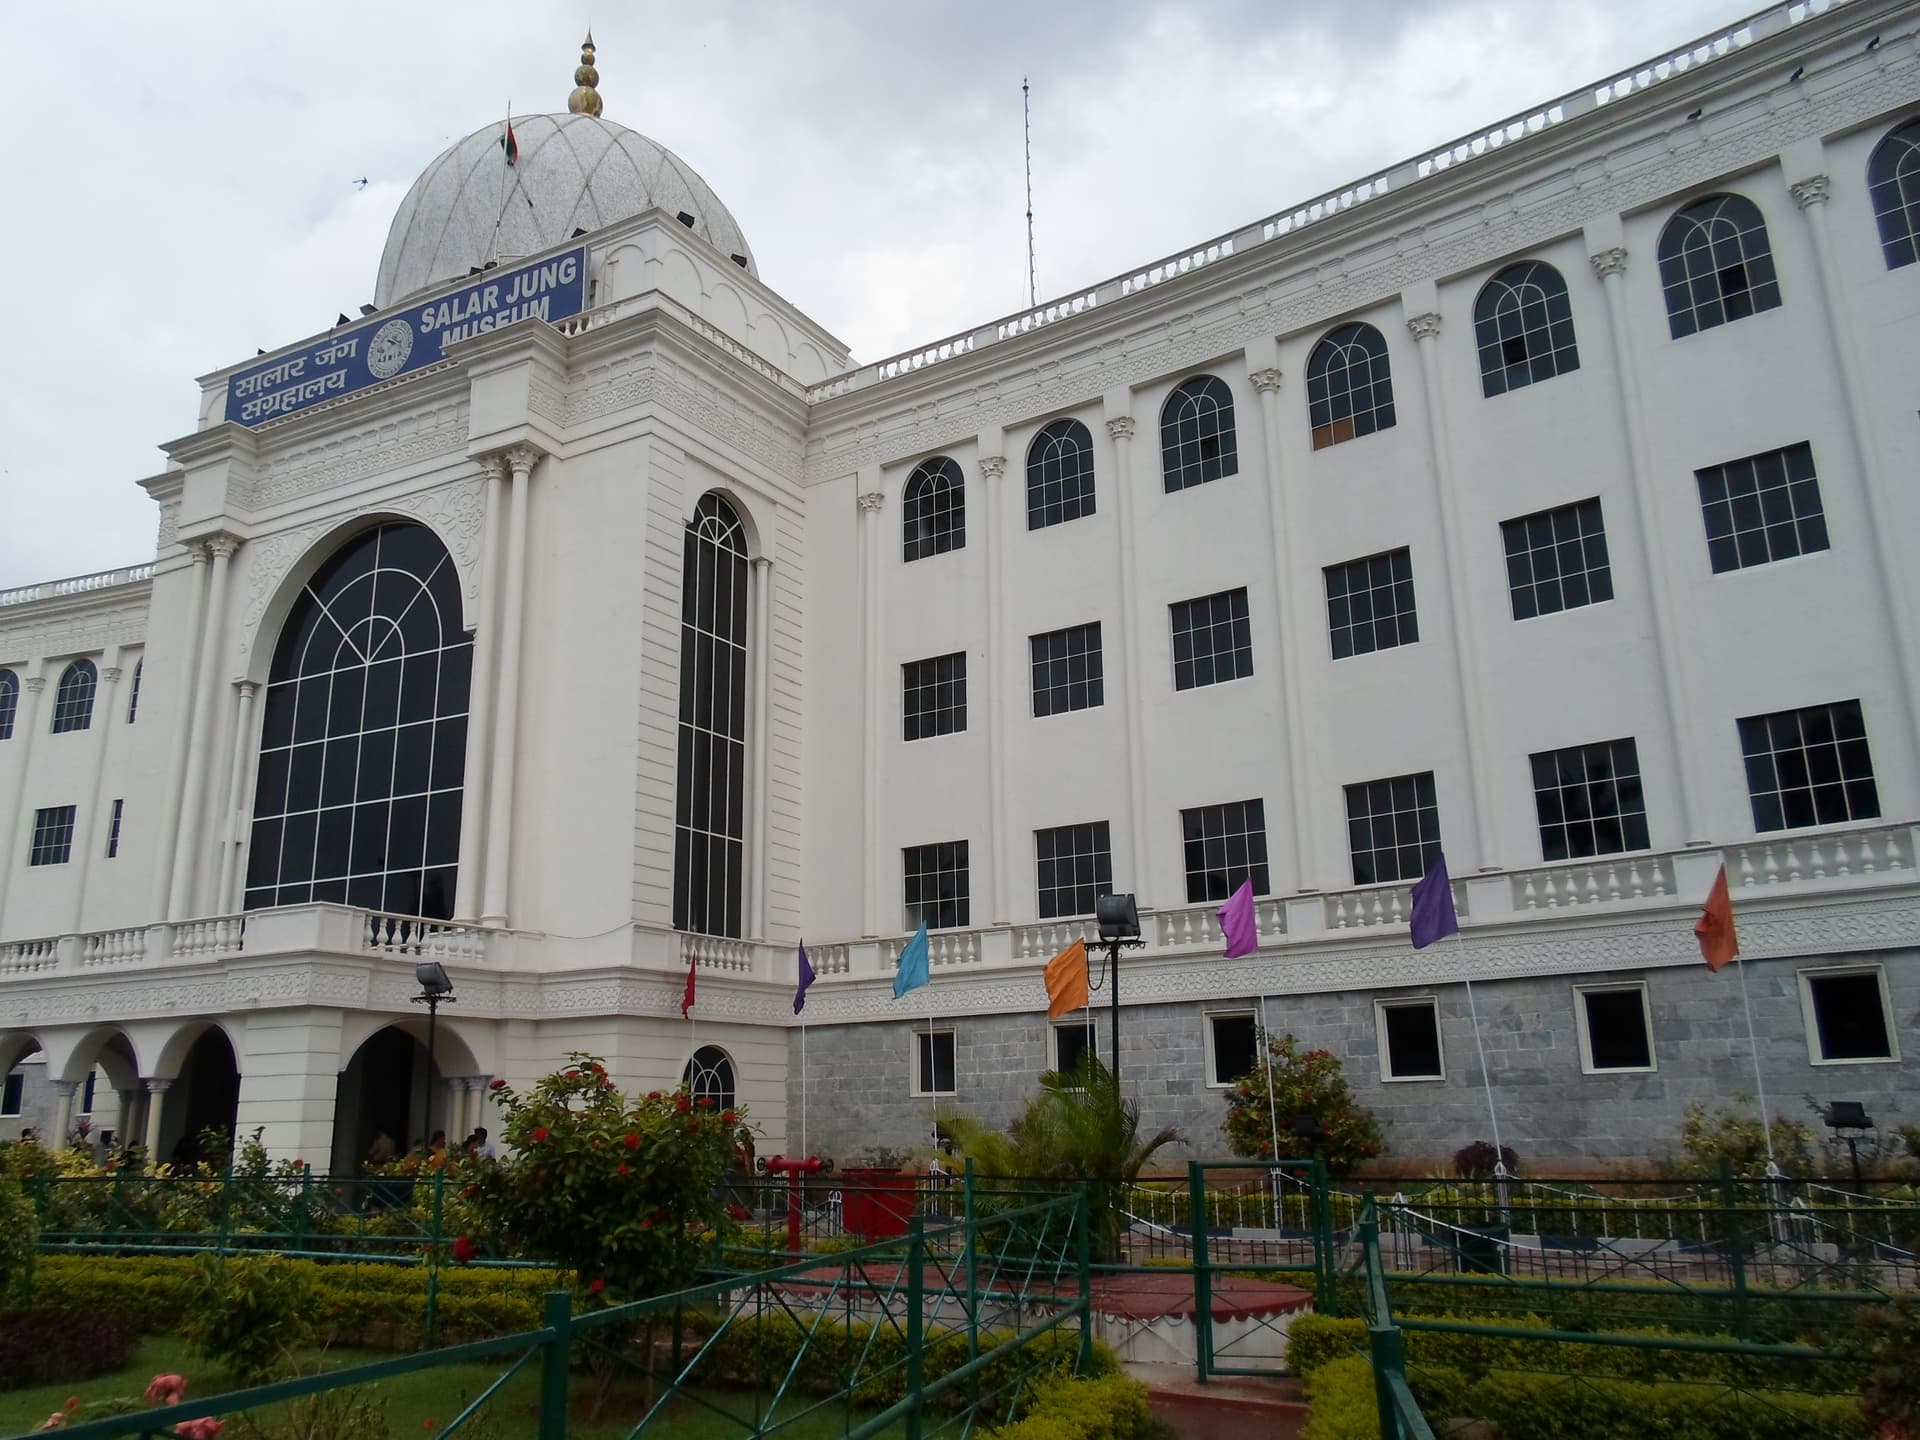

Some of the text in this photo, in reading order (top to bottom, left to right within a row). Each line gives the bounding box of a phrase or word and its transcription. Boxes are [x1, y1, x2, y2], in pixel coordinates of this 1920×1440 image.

[420, 256, 577, 334] SALAR JUNG
[235, 356, 308, 398] सालार
[314, 338, 359, 366] जंग
[241, 368, 348, 420] संग्रहालय
